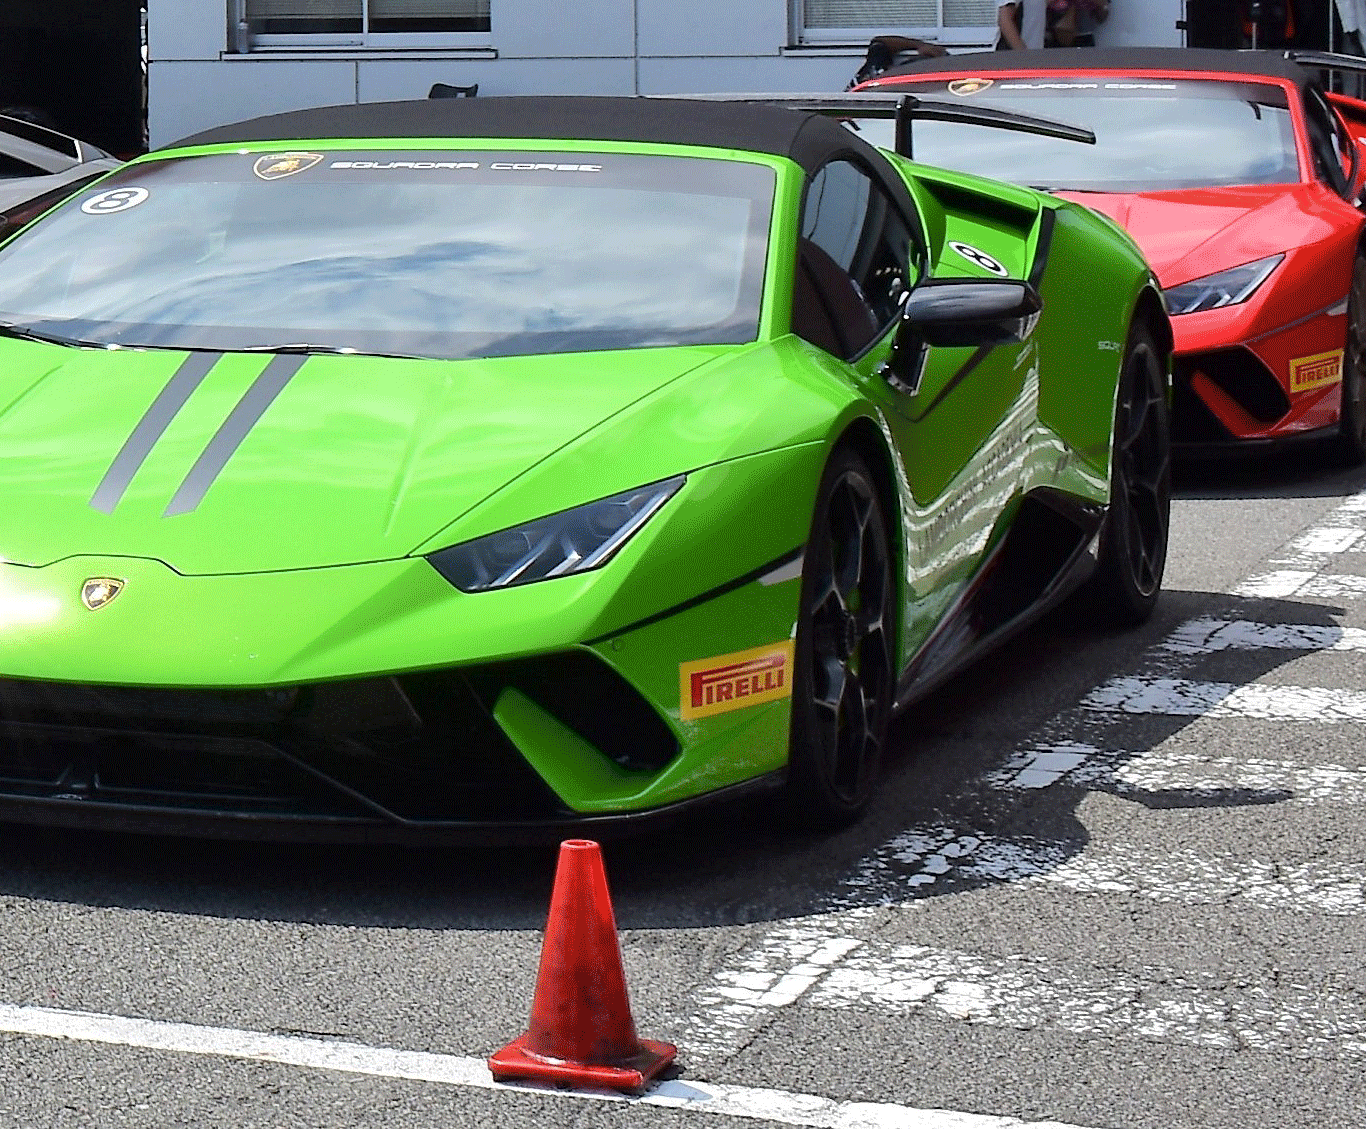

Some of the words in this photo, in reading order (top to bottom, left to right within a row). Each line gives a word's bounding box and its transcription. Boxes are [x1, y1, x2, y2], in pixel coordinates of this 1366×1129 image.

[329, 161, 480, 170] SQUADRA
[490, 161, 603, 173] CORSE
[90, 190, 139, 210] 8
[955, 245, 1002, 272] 8
[690, 654, 787, 708] PIRELLI
